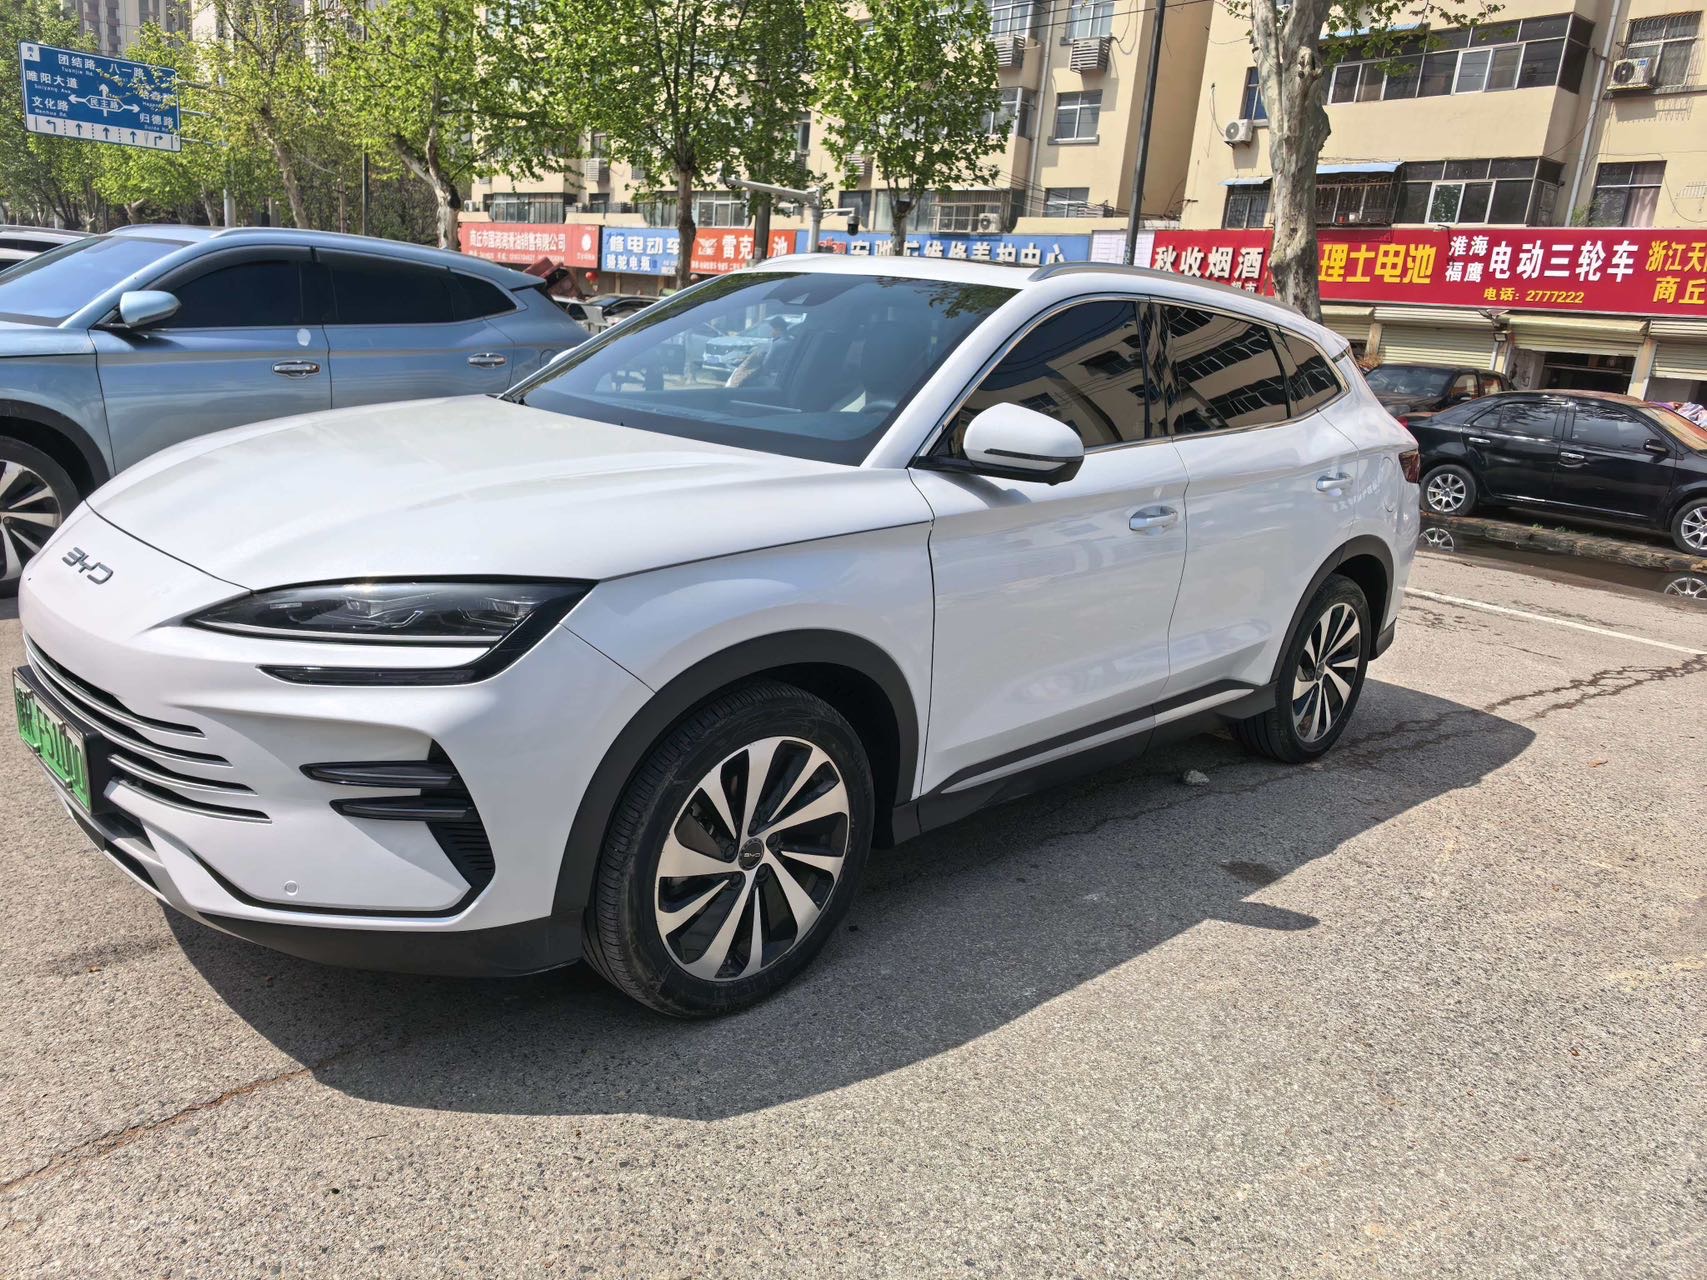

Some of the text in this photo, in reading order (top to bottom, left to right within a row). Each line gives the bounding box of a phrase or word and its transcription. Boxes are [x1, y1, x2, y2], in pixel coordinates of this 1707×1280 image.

[58, 54, 96, 70] 团结路
[26, 70, 79, 88] 睢阳大道
[32, 96, 69, 111] 文化路
[90, 97, 119, 110] 民主路
[139, 112, 174, 129] 归德路
[722, 234, 788, 259] 雷克池
[1448, 235, 1489, 257] 淮海
[1645, 240, 1707, 272] 浙江天
[1153, 245, 1264, 279] 秋收烟酒
[1319, 243, 1437, 284] 理士电池
[1445, 261, 1485, 283] 福鹰
[1488, 240, 1639, 283] 电动三轮车
[61, 546, 114, 585] BYD
